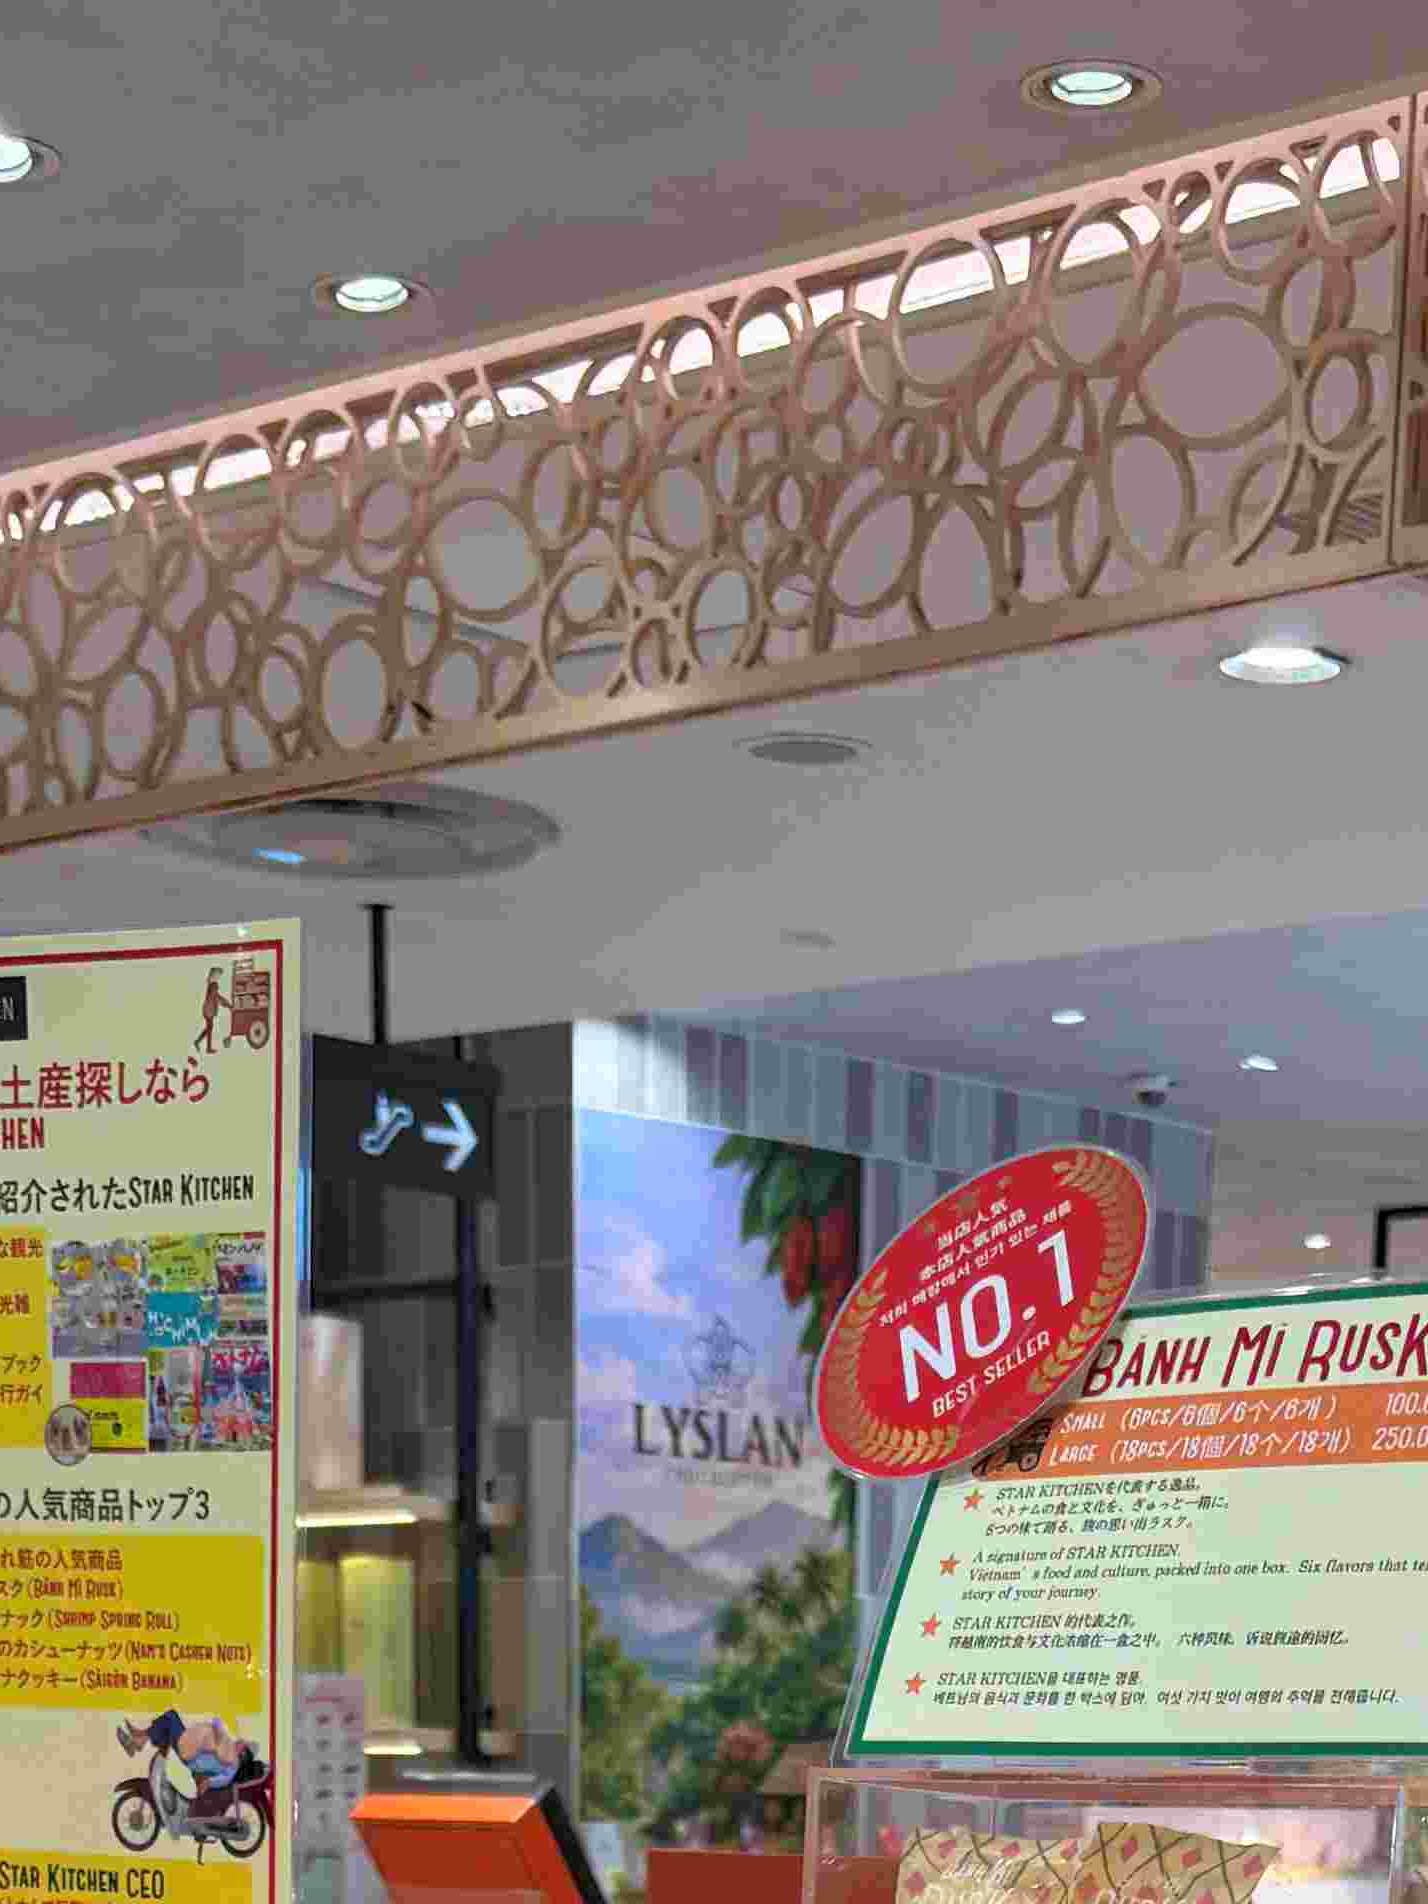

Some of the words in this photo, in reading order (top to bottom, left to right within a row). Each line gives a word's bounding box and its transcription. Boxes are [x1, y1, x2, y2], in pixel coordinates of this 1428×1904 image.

[181, 1174, 254, 1206] KITCHEN
[932, 1376, 979, 1418] BEST
[983, 1330, 1051, 1384] SELLER
[1060, 1412, 1105, 1434] SMALL
[1050, 1443, 1098, 1466] LARGE
[972, 1550, 984, 1564] A
[987, 1548, 1047, 1566] signature
[1049, 1546, 1065, 1562] of
[1066, 1545, 1109, 1561] STAR
[1042, 1565, 1071, 1580] food
[1074, 1565, 1099, 1580] and
[1155, 1562, 1201, 1582] packed
[1203, 1559, 1231, 1576] into
[1234, 1563, 1259, 1576] one
[1299, 1558, 1322, 1574] Six
[1325, 1557, 1374, 1574] flavors
[1378, 1557, 1406, 1573] that
[961, 1588, 993, 1602] story
[998, 1586, 1014, 1601] of
[1014, 1587, 1046, 1602] your
[47, 1863, 119, 1894] KITCHEN
[126, 1869, 166, 1899] CEO
